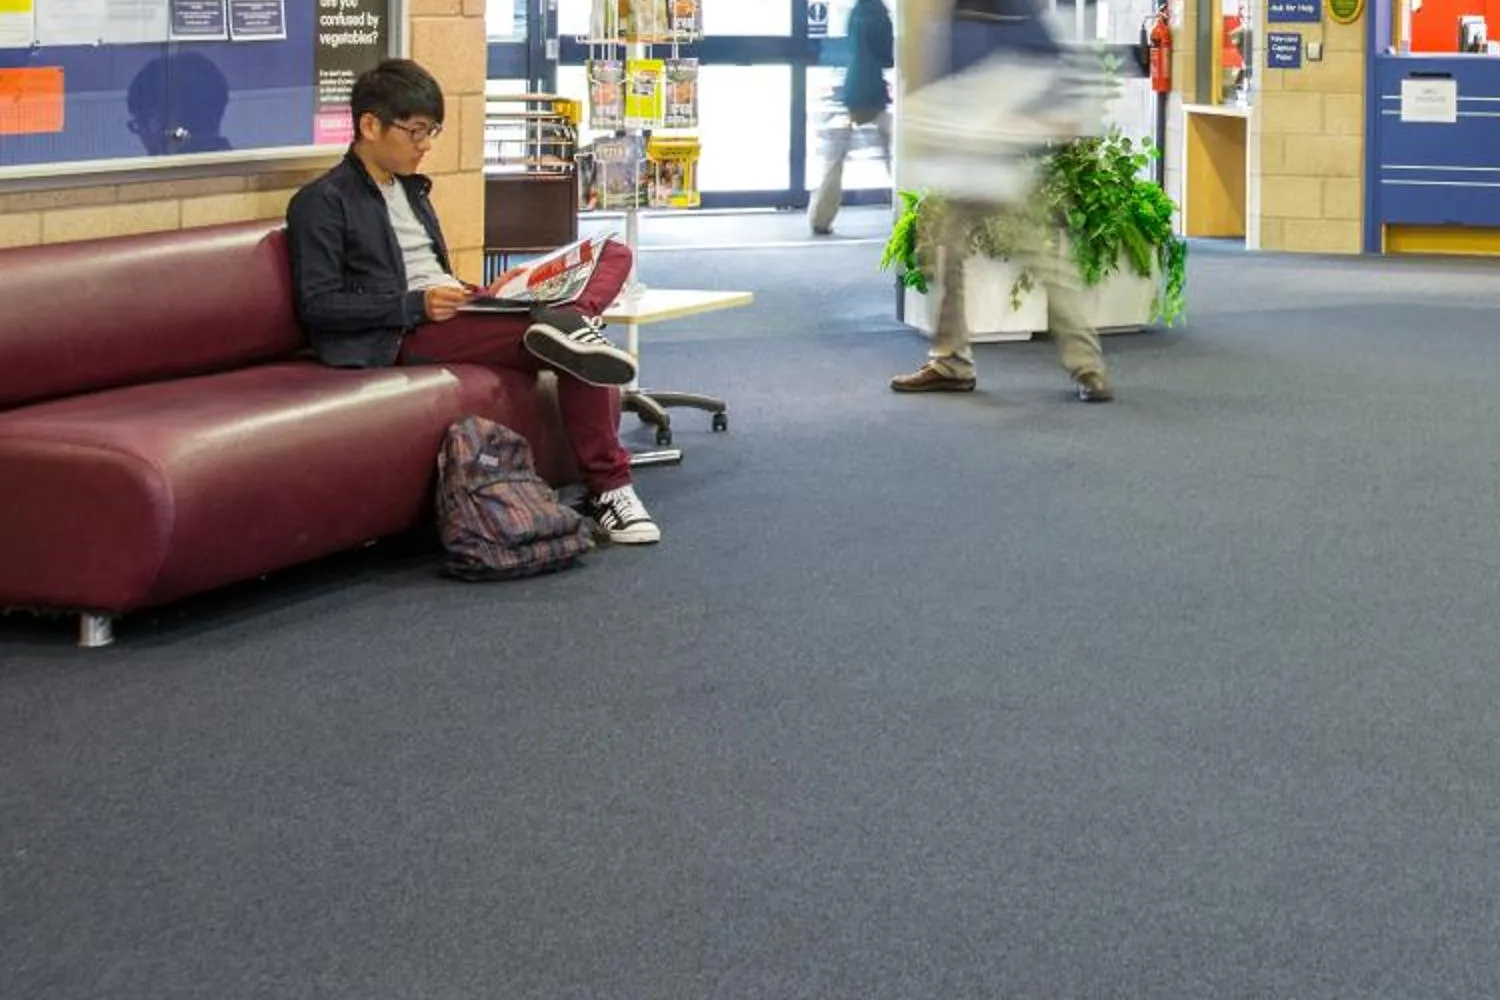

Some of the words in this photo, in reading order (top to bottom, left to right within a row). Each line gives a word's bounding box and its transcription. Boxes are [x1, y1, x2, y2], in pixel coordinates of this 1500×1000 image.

[320, 11, 365, 27] confused
[366, 11, 380, 29] by
[319, 29, 379, 48] vegetables?
